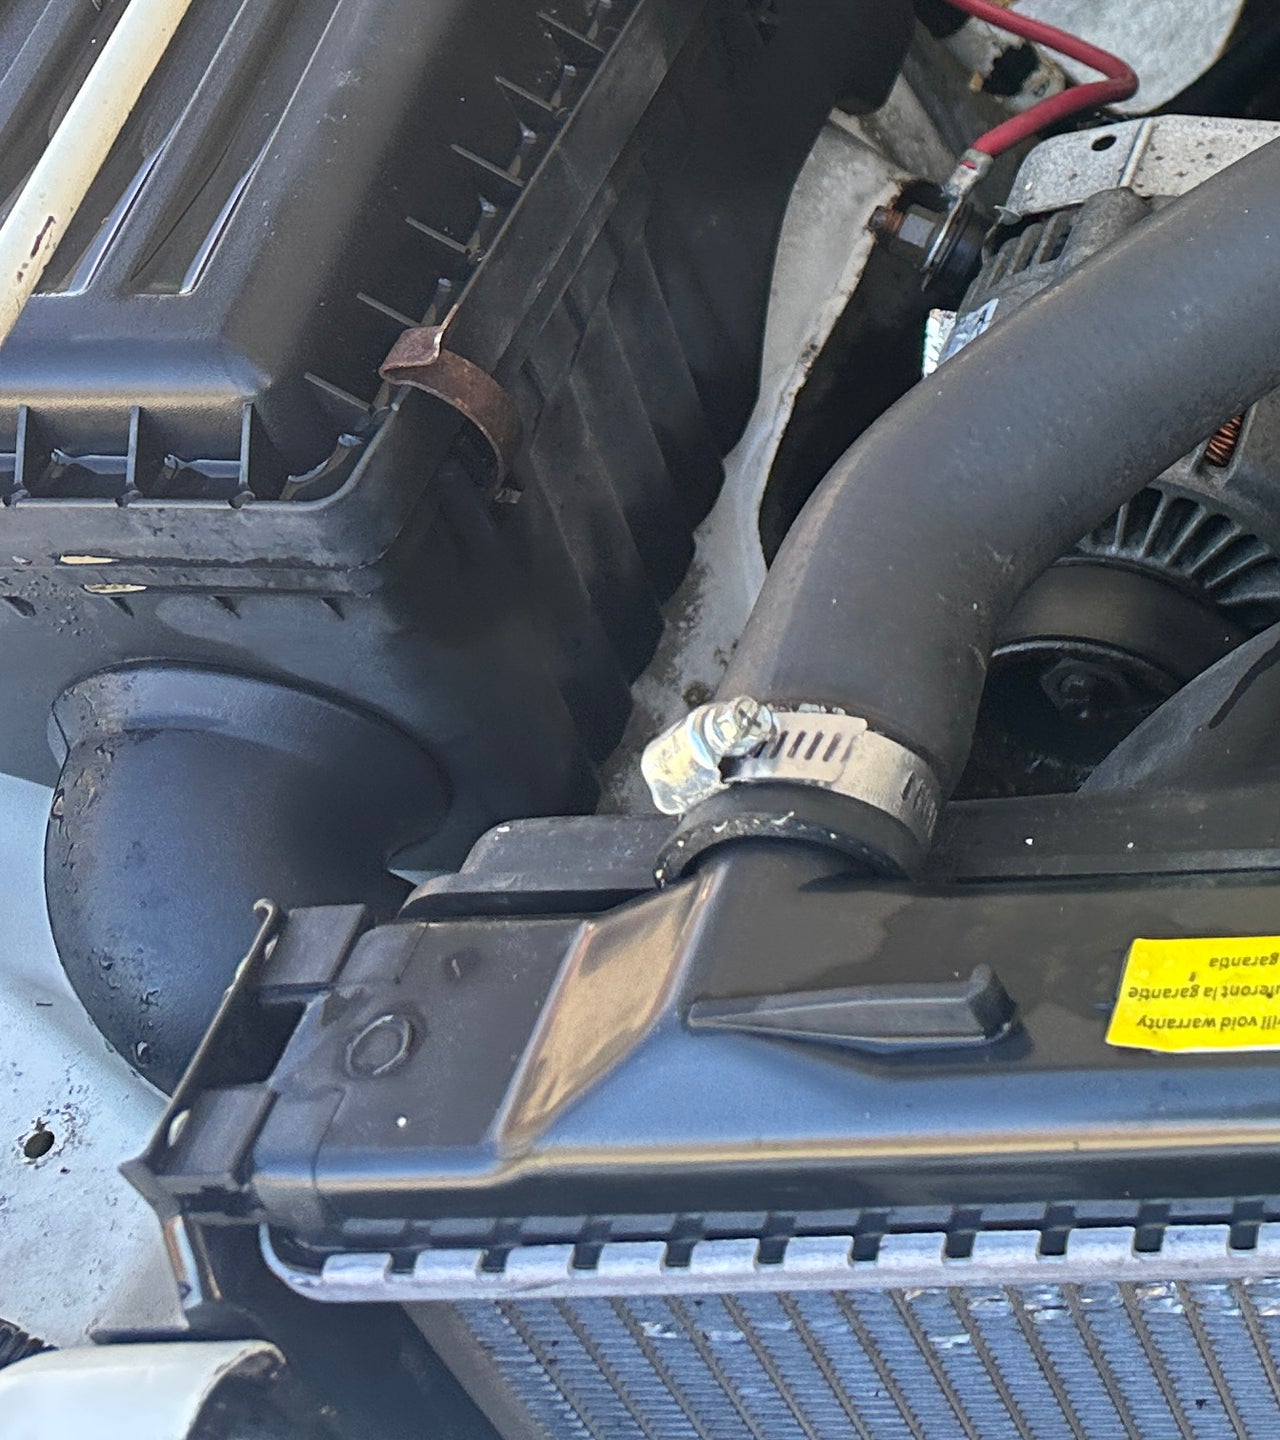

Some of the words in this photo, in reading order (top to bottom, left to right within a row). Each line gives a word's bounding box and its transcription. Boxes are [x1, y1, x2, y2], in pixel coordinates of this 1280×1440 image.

[1208, 951, 1280, 968] garantia
[1127, 984, 1199, 1000] garantie
[1204, 984, 1218, 999] la
[1136, 1014, 1217, 1031] warranty
[1220, 1015, 1258, 1030] void
